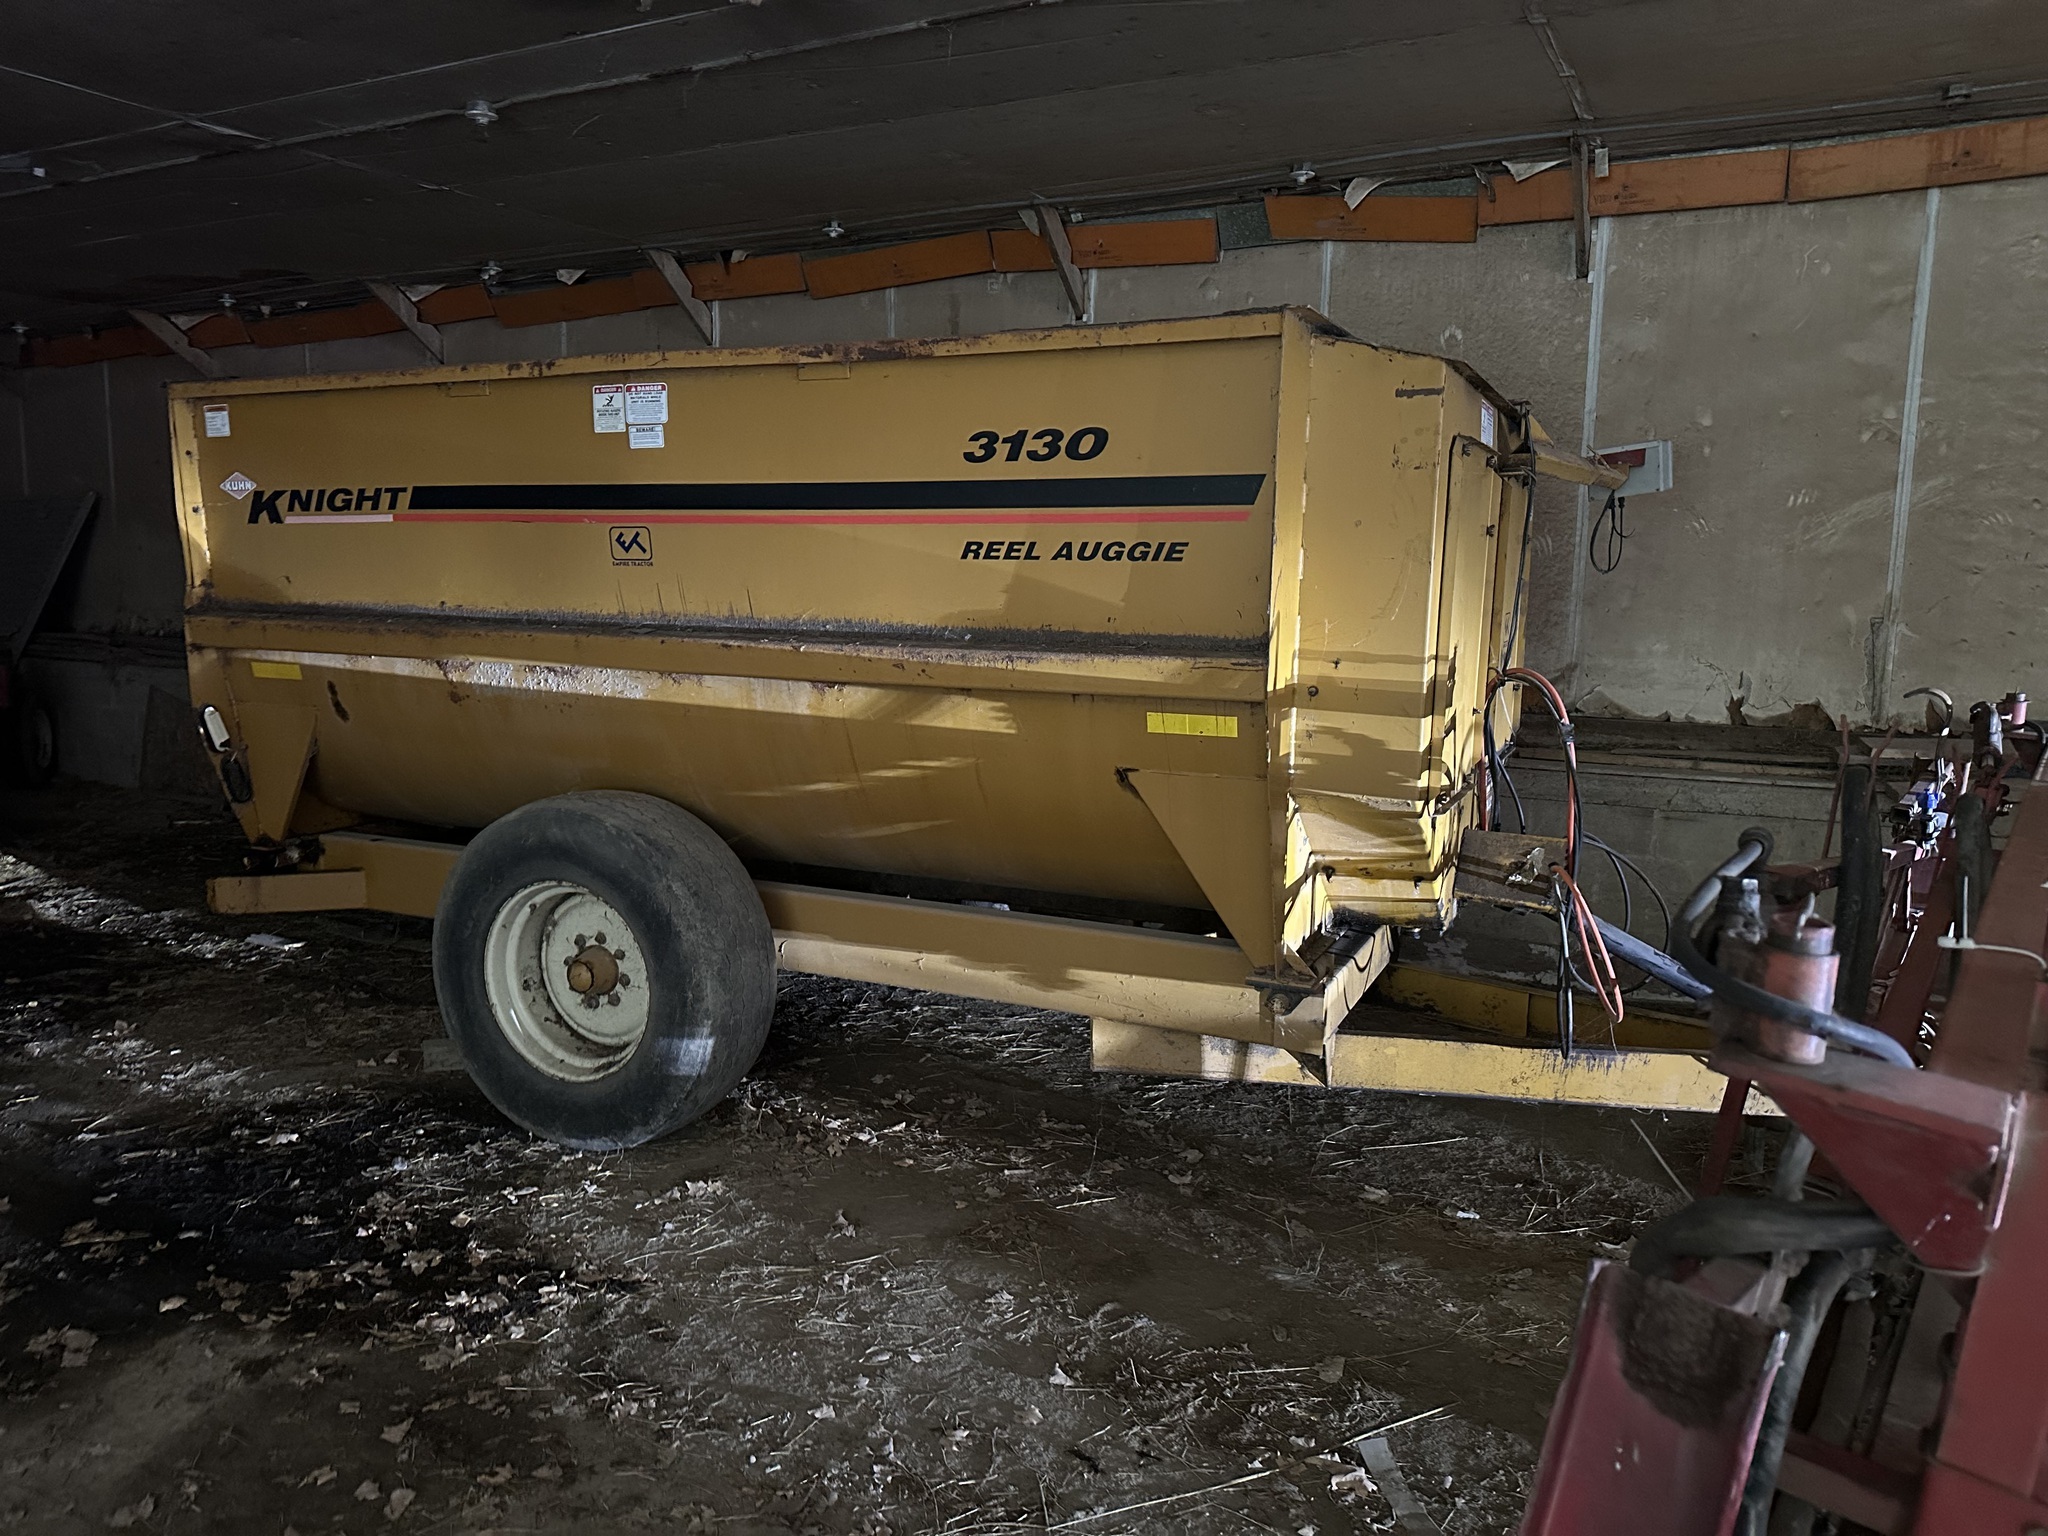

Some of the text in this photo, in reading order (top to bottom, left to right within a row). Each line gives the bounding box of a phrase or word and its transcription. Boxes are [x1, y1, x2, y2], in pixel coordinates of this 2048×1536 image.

[963, 427, 1109, 463] 3130
[226, 481, 252, 491] KUHN
[247, 487, 408, 524] KNIGHT
[960, 541, 1189, 562] REEL AUGGIE
